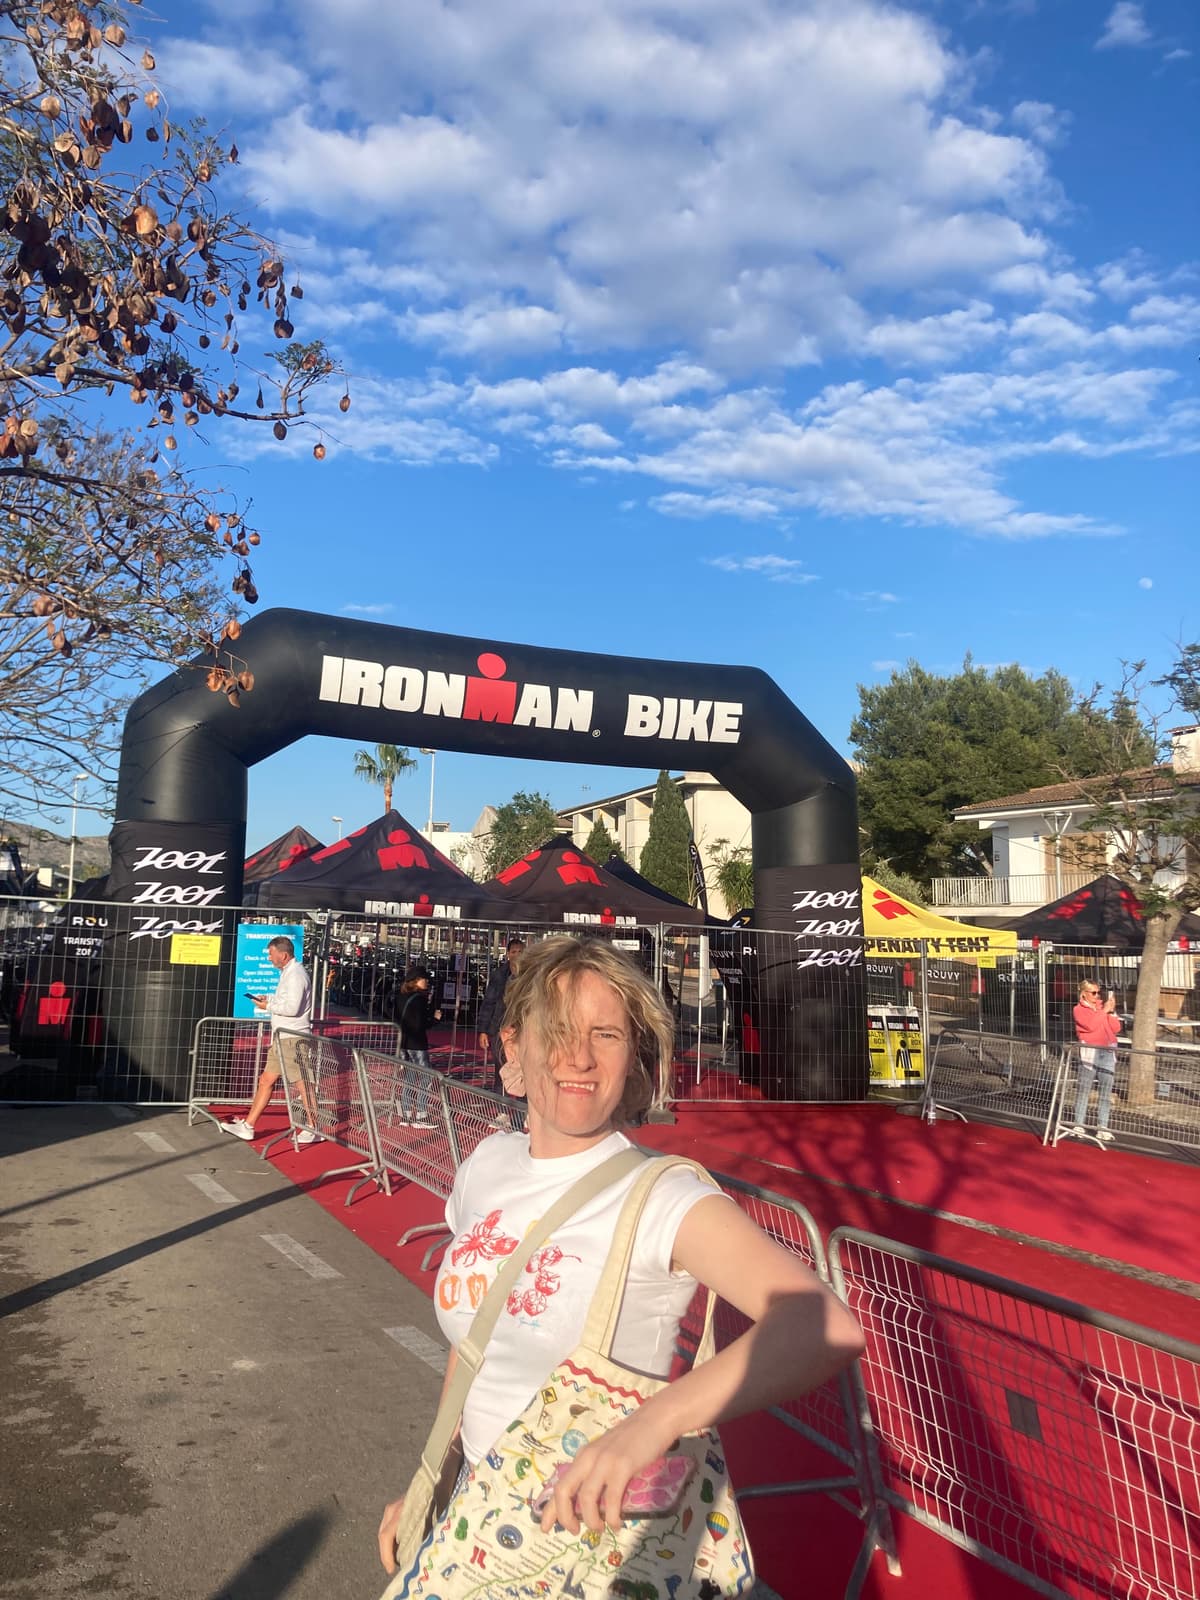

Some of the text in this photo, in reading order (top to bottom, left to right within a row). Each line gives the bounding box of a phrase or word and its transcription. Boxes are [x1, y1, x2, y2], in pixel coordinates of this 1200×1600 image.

[319, 653, 743, 744] IRONMAN BIKE
[364, 894, 461, 919] IRONMAN
[563, 908, 637, 928] IRONMAN
[863, 936, 990, 953] PENALTY TENT
[866, 964, 894, 974] ROUVY
[927, 969, 961, 981] ROUVY
